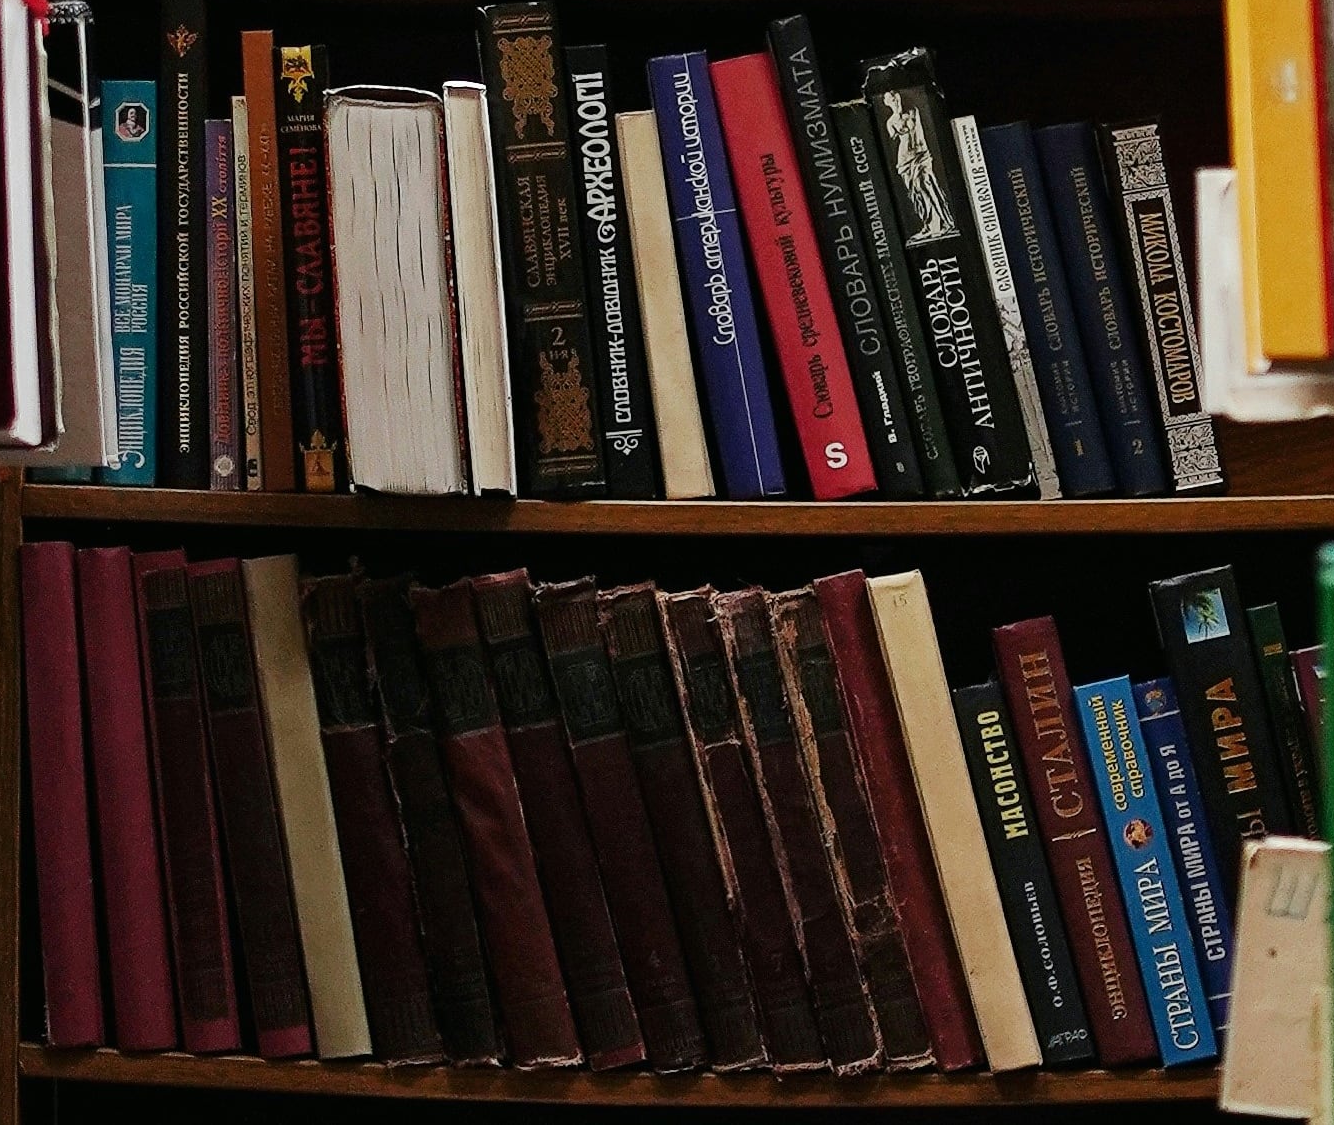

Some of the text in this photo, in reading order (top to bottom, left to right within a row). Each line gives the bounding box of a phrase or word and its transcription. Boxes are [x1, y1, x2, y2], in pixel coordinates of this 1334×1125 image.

[216, 134, 228, 193] століття
[518, 175, 541, 287] СЛАВЯНСКАЯ
[535, 174, 557, 285] ЭНЦИКЛОПЕДИЯ
[557, 198, 569, 222] век
[572, 71, 632, 423] СЛОВНИК-ДОВІДНИК АРХЕОЛОГІЇ
[672, 72, 736, 344] Словарь американской истории
[789, 46, 897, 443] В. Гладкий СЛОВАРЬ НУМИЗМАТА
[859, 179, 891, 258] НАЗВАНИЙ
[968, 166, 1012, 291] СЛОВНИК СИМВОЛІВ
[114, 205, 133, 333] ВСЕ МОНАРХИ МИРА
[131, 284, 148, 333] РОССИЯ
[175, 72, 192, 453] ЭНЦИКЛОПЕДИЯ РОССИЙСКОЙ ГОСУДАРСТВЕННОСТИ
[236, 154, 258, 436] Свод понятий и терминов
[289, 146, 328, 366] МЫ СЛАВЯНЕ!
[551, 326, 566, 346] 2
[758, 153, 834, 419] Словарь средневековой культуры
[918, 257, 957, 368] СЛОВАРЬ
[939, 256, 995, 428] АНТИЧНОСТИ
[1007, 167, 1065, 351] СЛОВАРЬ ИСТОРИЧЕСКИЙ
[1069, 165, 1123, 350] СЛОВАРЬ ИСТОРИЧЕСКИЙ
[1138, 212, 1196, 403] МИКОЛА КОСТОМАРОВ
[824, 442, 849, 469] S
[1086, 694, 1130, 811] современный
[1111, 698, 1145, 799] справочник
[1204, 677, 1259, 794] МИРА
[977, 709, 1064, 1008] О.Ф.СОЛОВЬЕВ МАСОНСТВО
[1018, 648, 1129, 1020] ЭНЦИКЛОПЕДИЯ СТАЛИН
[1160, 744, 1227, 961] СТРАНЫ МИРА от А до Я
[1135, 857, 1201, 1051] СТРАНЫ МИРА
